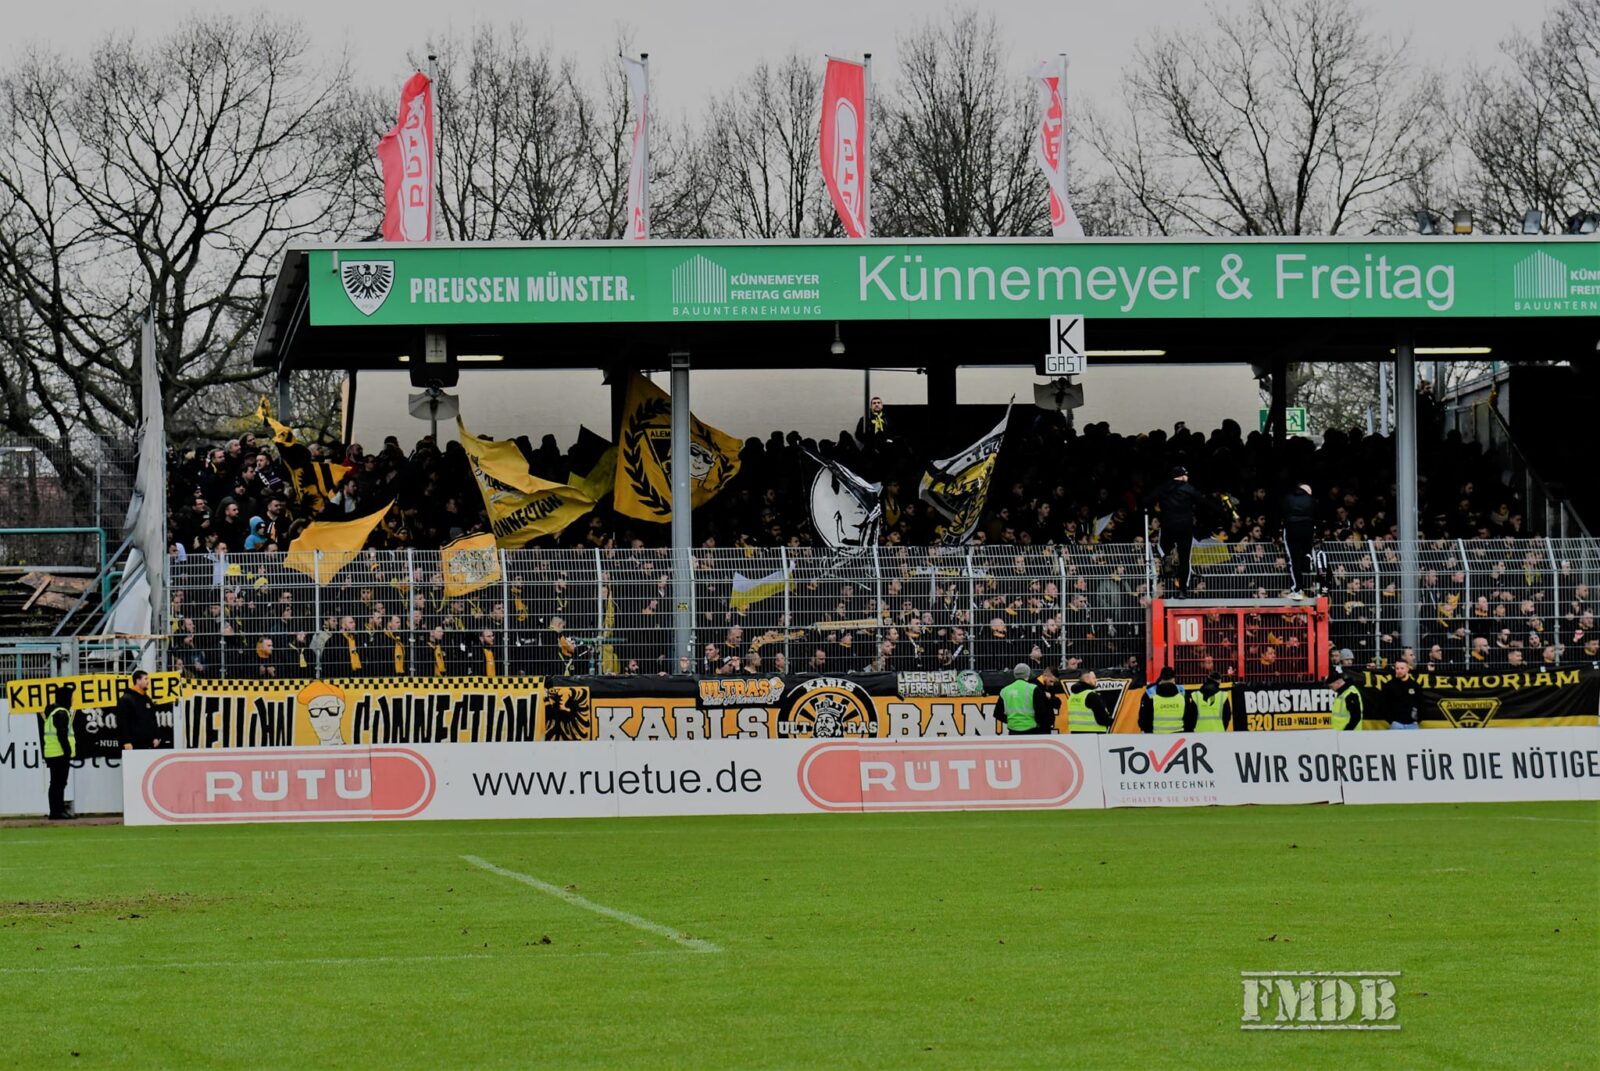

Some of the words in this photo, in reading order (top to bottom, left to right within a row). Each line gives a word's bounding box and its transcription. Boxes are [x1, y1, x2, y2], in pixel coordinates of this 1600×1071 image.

[527, 271, 635, 302] MÜNSTER.
[731, 273, 819, 285] KÜNNEMEYER
[859, 255, 1200, 312] Künnemeyer
[1216, 253, 1253, 300] &
[1275, 253, 1455, 311] Freitag
[731, 290, 779, 300] FREITAG
[783, 289, 819, 299] GMBH
[673, 305, 822, 315] BAUUNTERNEHMUNG
[1514, 300, 1598, 311] BAUUNTERN
[1057, 318, 1079, 354] K
[1047, 356, 1085, 372] GAST
[494, 494, 564, 540] ONNECTION
[1177, 618, 1199, 642] 10
[700, 680, 769, 699] ULTRAS
[803, 678, 856, 692] KARLS
[353, 694, 537, 744] CONNECTION
[596, 707, 768, 740] KARLS
[778, 721, 810, 734] ULT
[846, 721, 878, 734] RAS
[1247, 714, 1272, 731] 520
[1277, 717, 1292, 726] FELD
[1297, 716, 1317, 726] WALD
[860, 759, 1022, 792] RÜTÜ
[1298, 754, 1397, 782] SORGEN
[1406, 749, 1455, 781] FÜR
[1462, 752, 1503, 780] DIE
[206, 768, 371, 802] RÜTÜ
[472, 761, 762, 796] www.ruetue.de
[1120, 781, 1216, 790] ELEKTROTECHNIK
